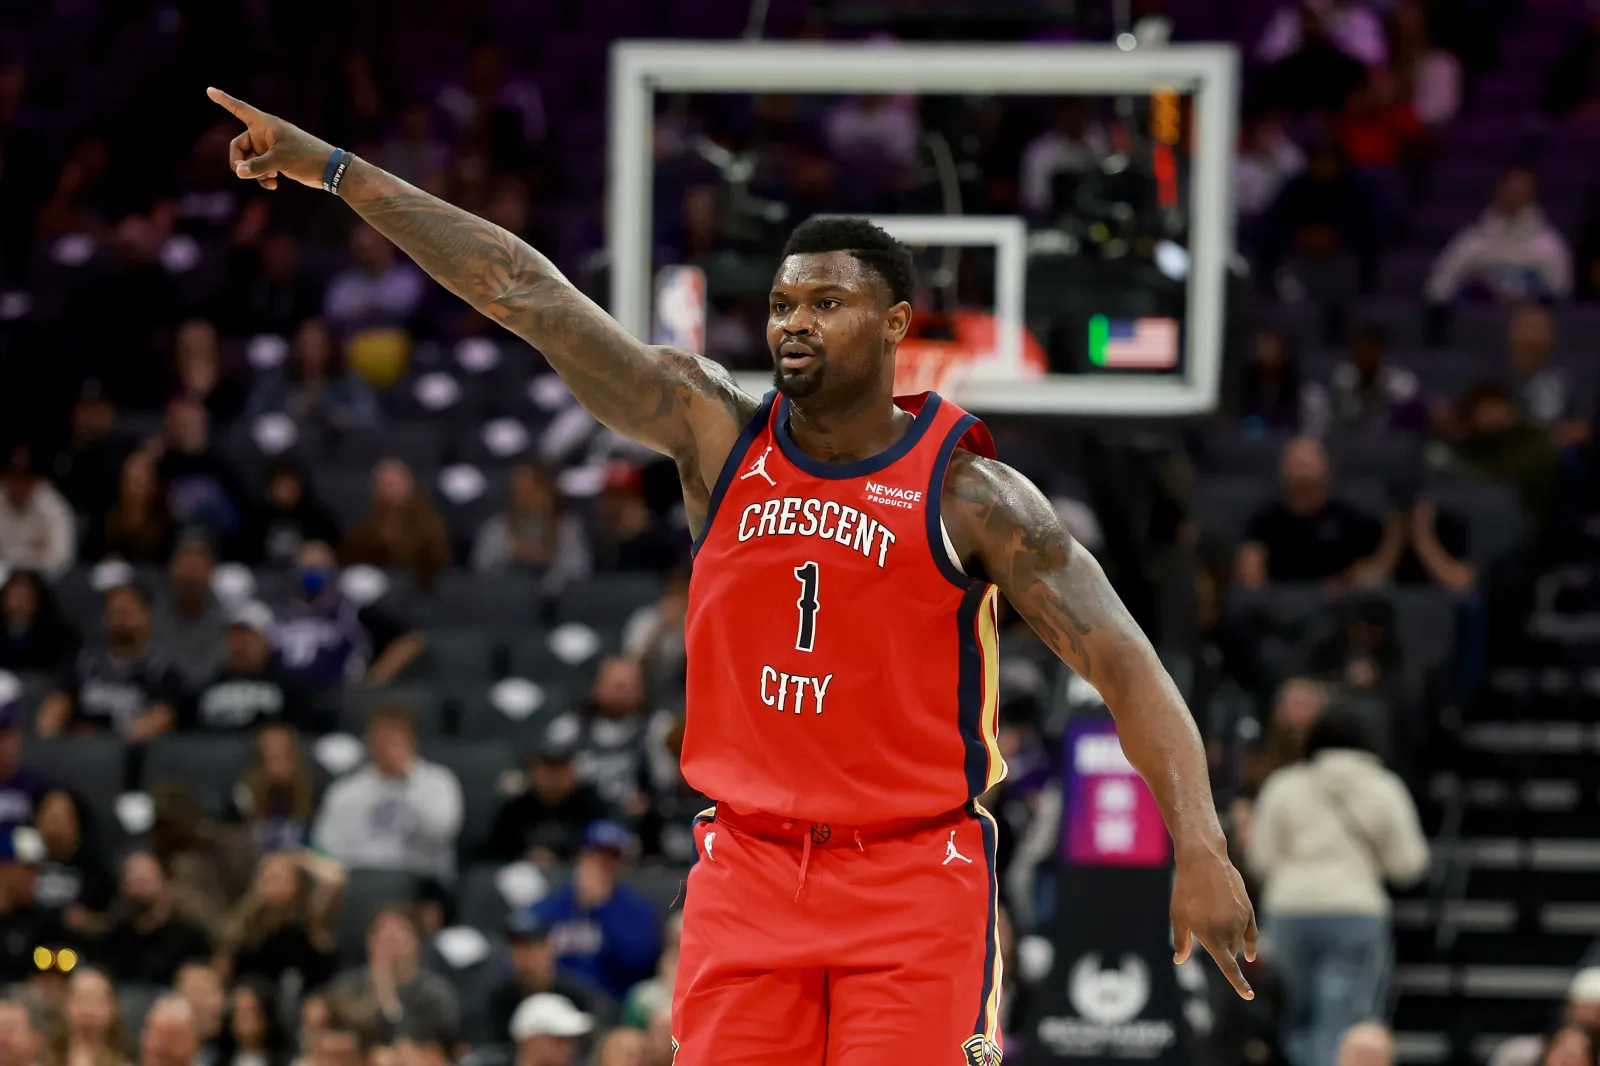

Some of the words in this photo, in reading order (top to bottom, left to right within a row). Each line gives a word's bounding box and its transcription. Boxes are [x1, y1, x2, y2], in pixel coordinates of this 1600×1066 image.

[332, 163, 346, 187] READY
[865, 480, 922, 502] NEWAGE
[867, 494, 913, 509] PRODUCTS
[737, 497, 896, 568] CRESCENT
[793, 560, 820, 653] 1
[760, 664, 833, 714] CITY
